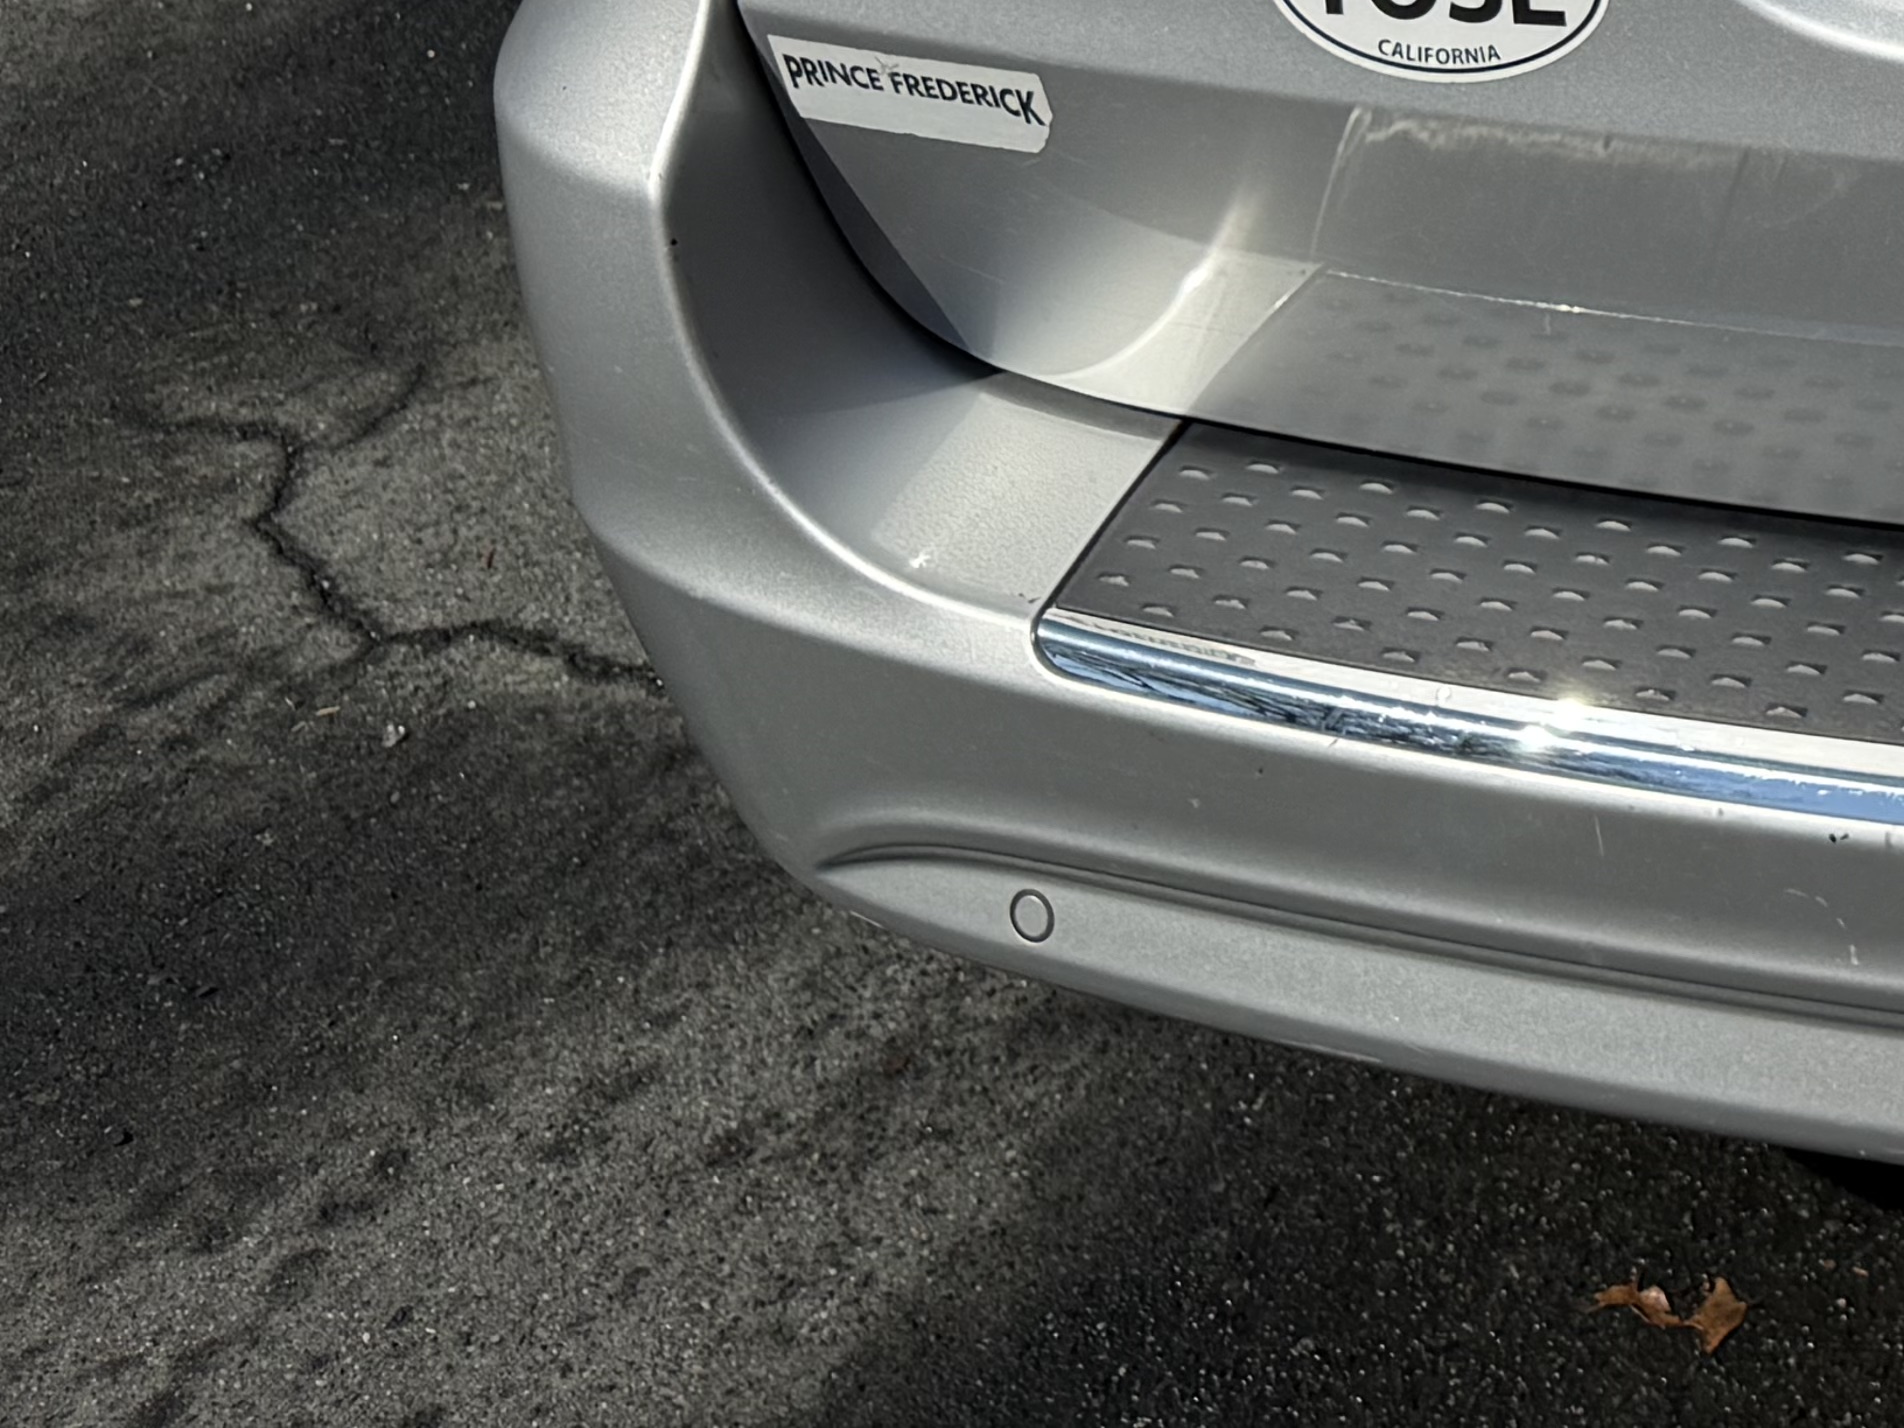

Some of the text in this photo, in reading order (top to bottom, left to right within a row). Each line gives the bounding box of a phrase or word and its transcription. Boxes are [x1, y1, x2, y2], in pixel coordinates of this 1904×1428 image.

[1376, 38, 1502, 66] CALIFORNIA
[781, 52, 1048, 127] PRINCE FREDERICK
